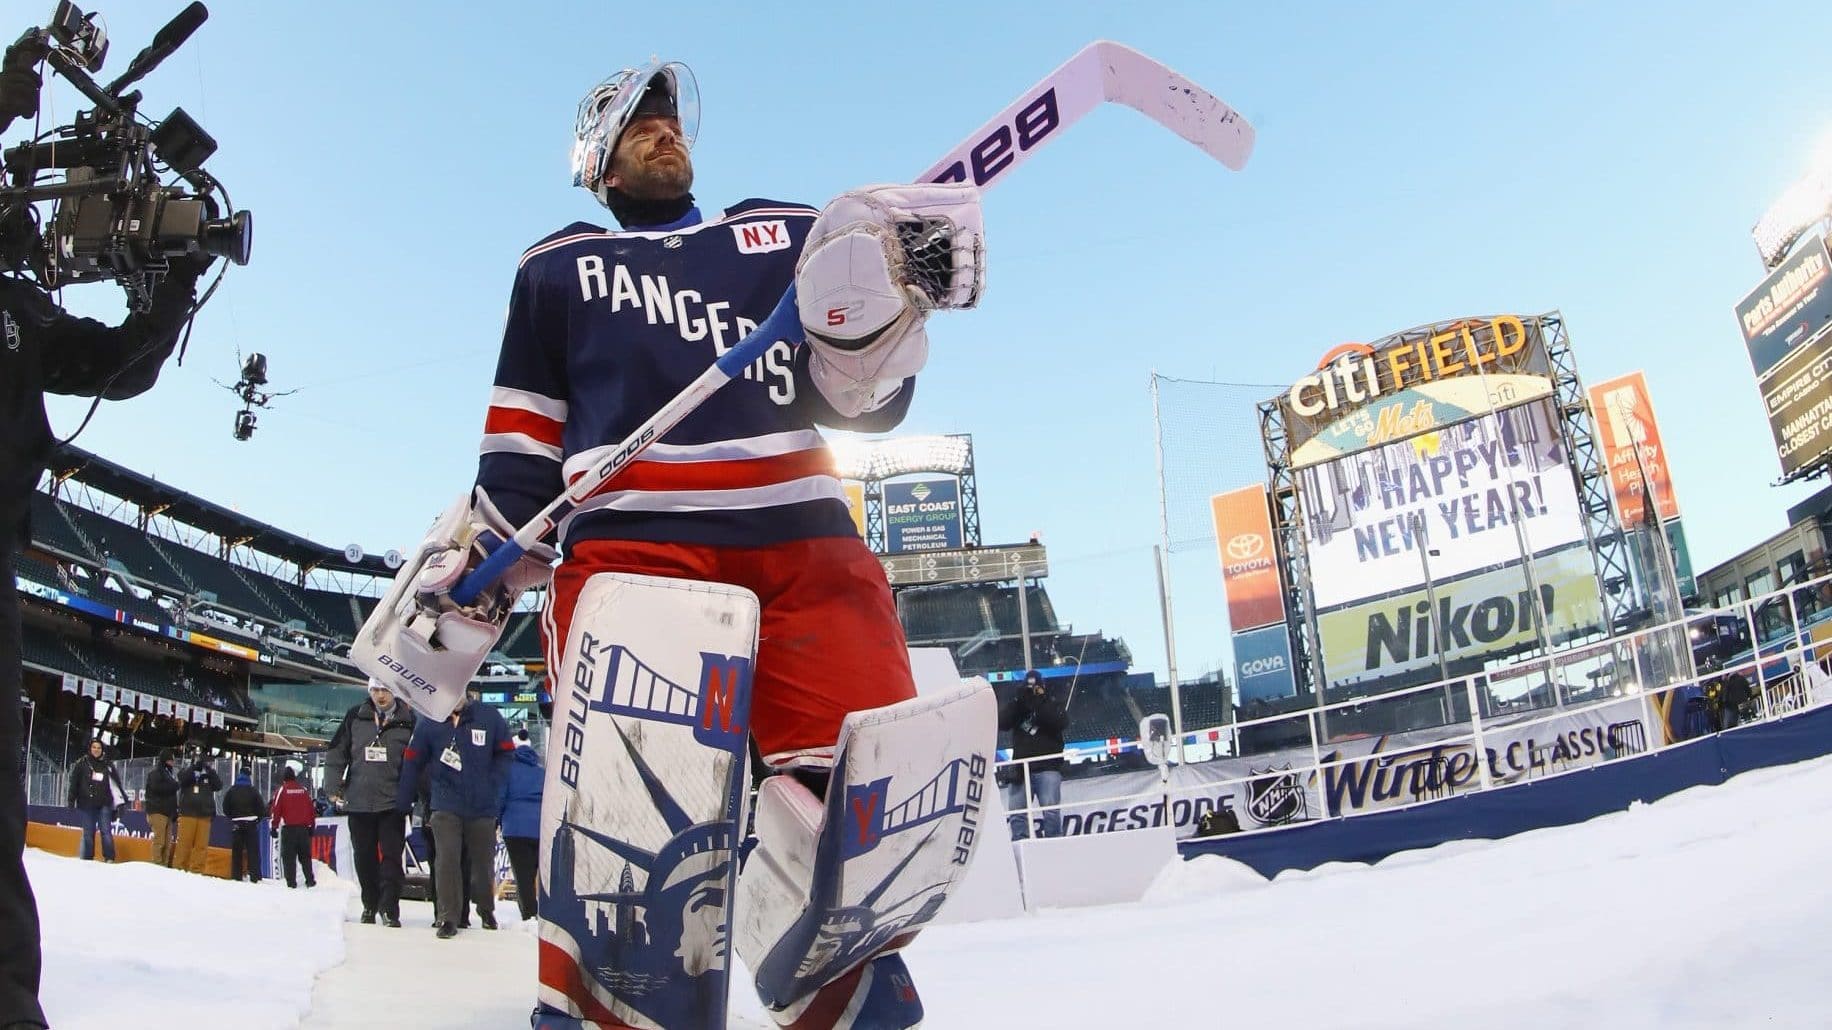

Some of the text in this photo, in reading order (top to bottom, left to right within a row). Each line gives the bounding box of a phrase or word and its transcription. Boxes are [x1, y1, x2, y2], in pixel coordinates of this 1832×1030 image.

[742, 223, 786, 249] N.Y.
[1743, 295, 1776, 331] Parts
[1770, 252, 1825, 308] Authority
[1388, 314, 1527, 390] FIELD
[1769, 372, 1812, 409] EMPIRE
[1793, 379, 1820, 402] CASINO
[1367, 399, 1434, 447] Mets
[1778, 421, 1820, 458] CLOSEST
[887, 500, 957, 514] EAST COAST
[888, 512, 957, 524] ENERGY GROUP
[1354, 475, 1548, 562] NEW YEAR!
[902, 526, 926, 534] POWER
[902, 533, 948, 542] MECHANICAL
[350, 548, 358, 558] 31
[902, 541, 948, 550] PETROLEUM
[388, 553, 398, 563] 41
[1226, 557, 1272, 575] TOYOTA
[1366, 583, 1556, 671] Nikon
[1241, 655, 1285, 676] GOYA
